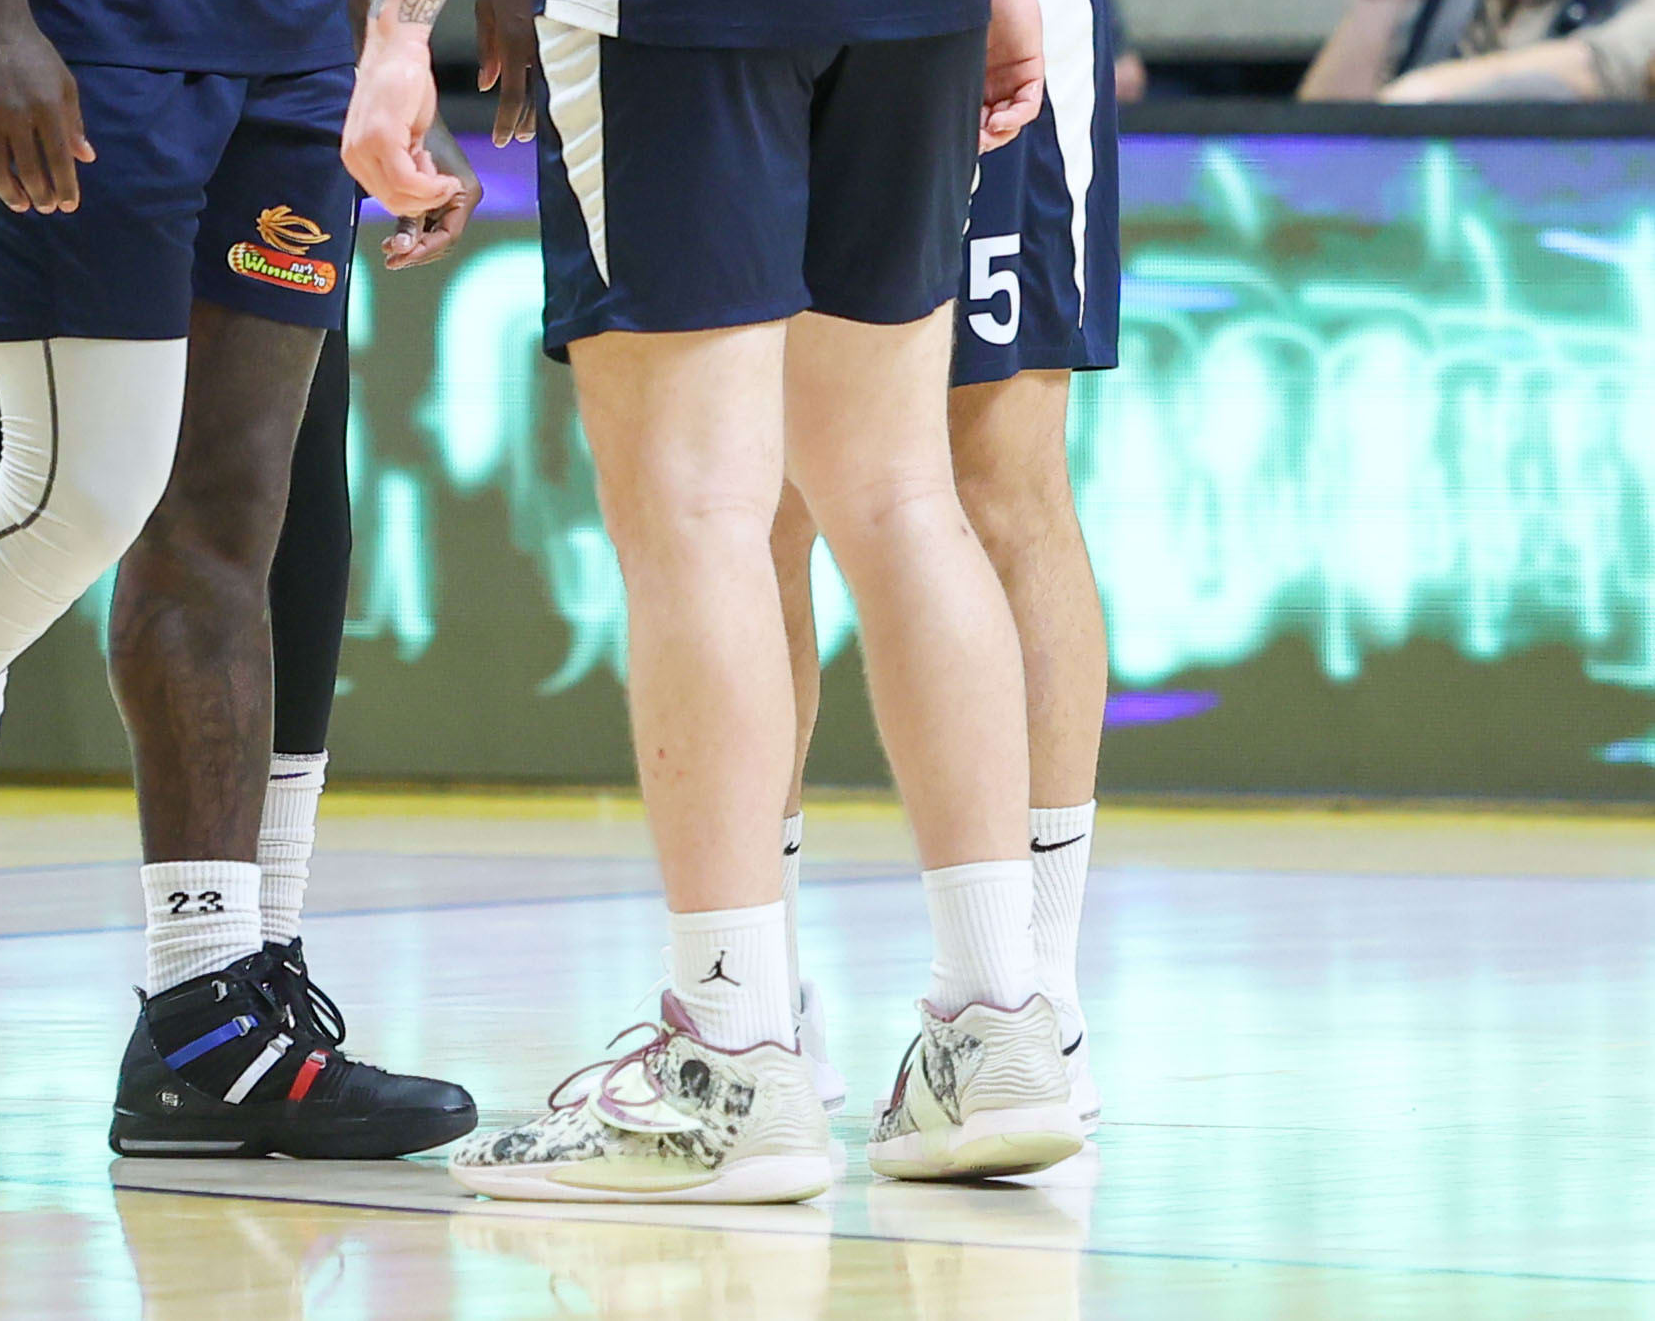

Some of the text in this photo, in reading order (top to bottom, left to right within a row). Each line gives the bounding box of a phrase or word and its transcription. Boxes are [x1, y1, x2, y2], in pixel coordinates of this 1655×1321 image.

[244, 253, 313, 285] Winner
[968, 233, 1021, 345] 5
[168, 890, 224, 914] 23
